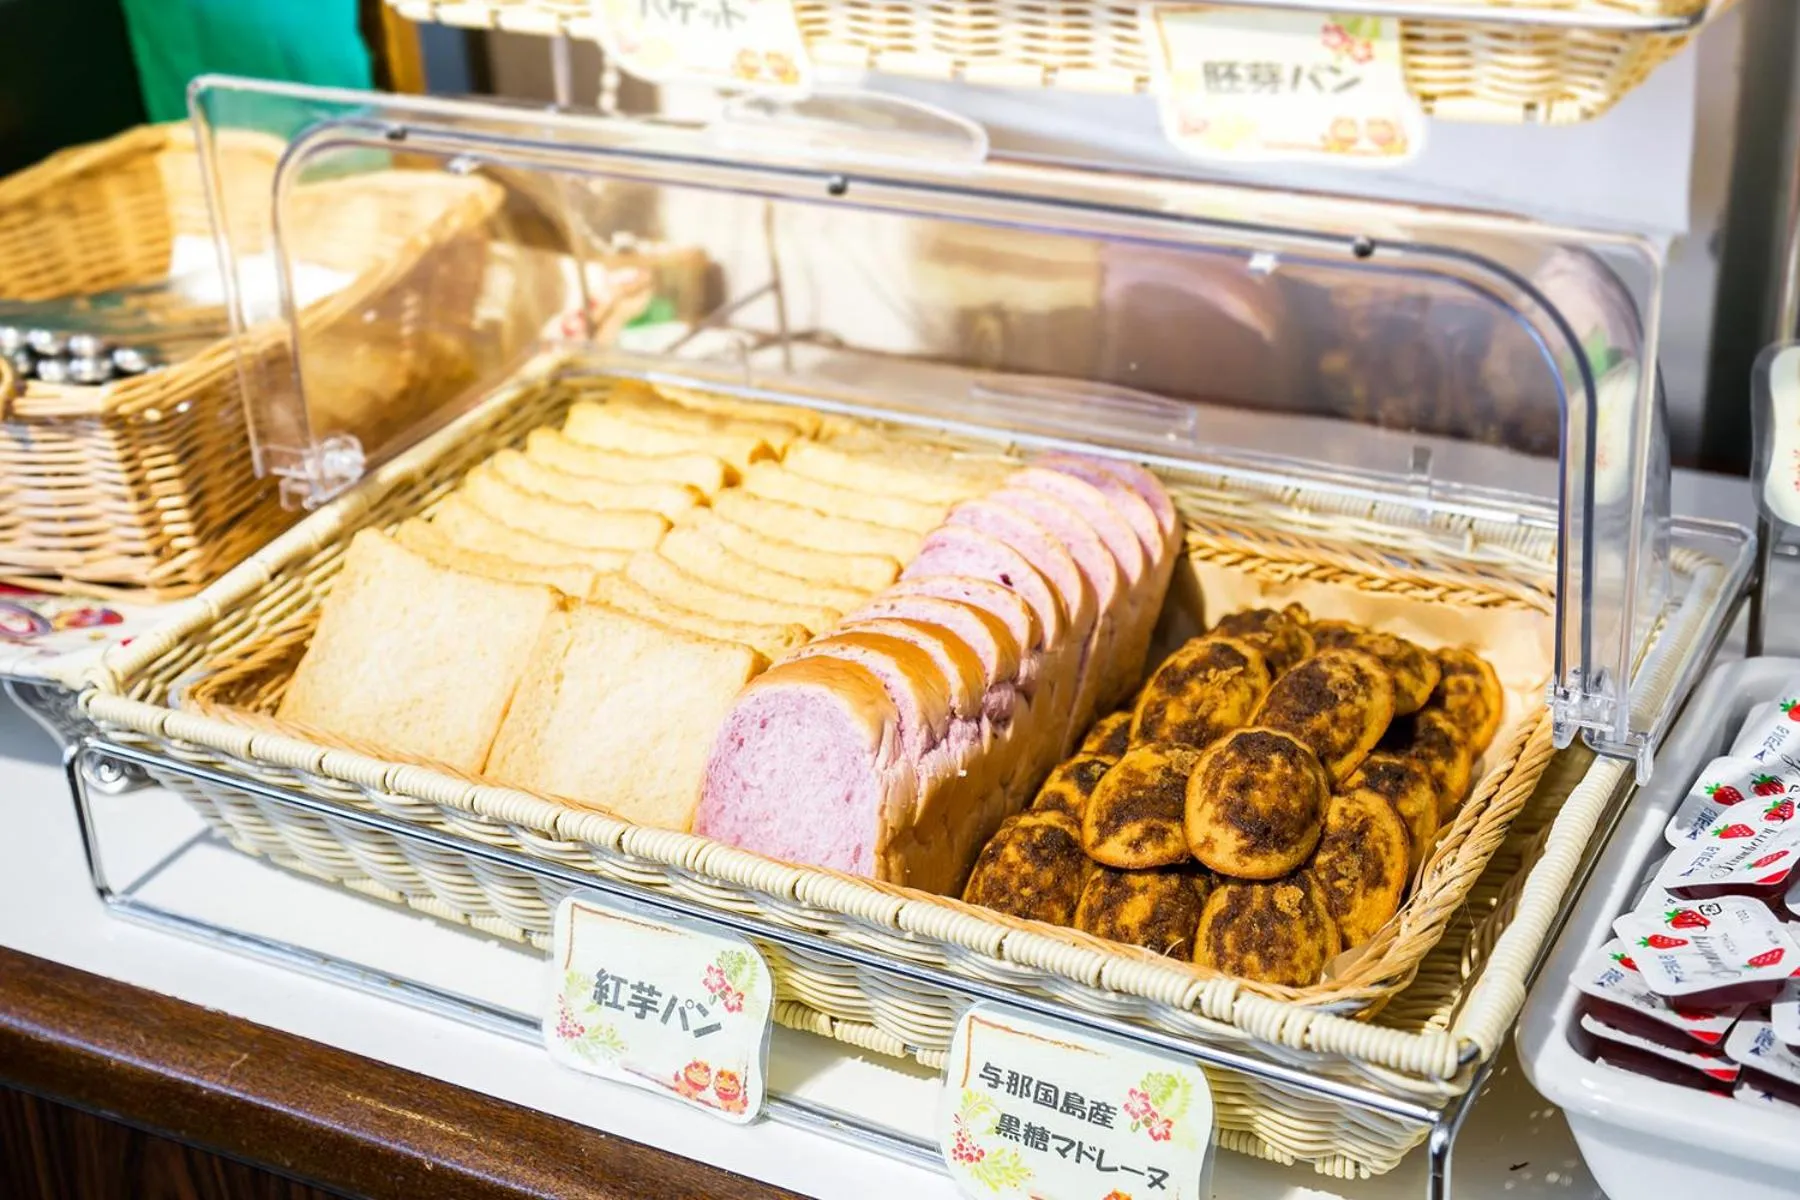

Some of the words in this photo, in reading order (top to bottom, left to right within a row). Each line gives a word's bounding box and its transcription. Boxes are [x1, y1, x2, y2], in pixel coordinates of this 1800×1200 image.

[591, 967, 723, 1039] 紅芋パン
[978, 1061, 1118, 1130] 与那国島産
[994, 1112, 1170, 1191] 黒糖マドレーヌ
